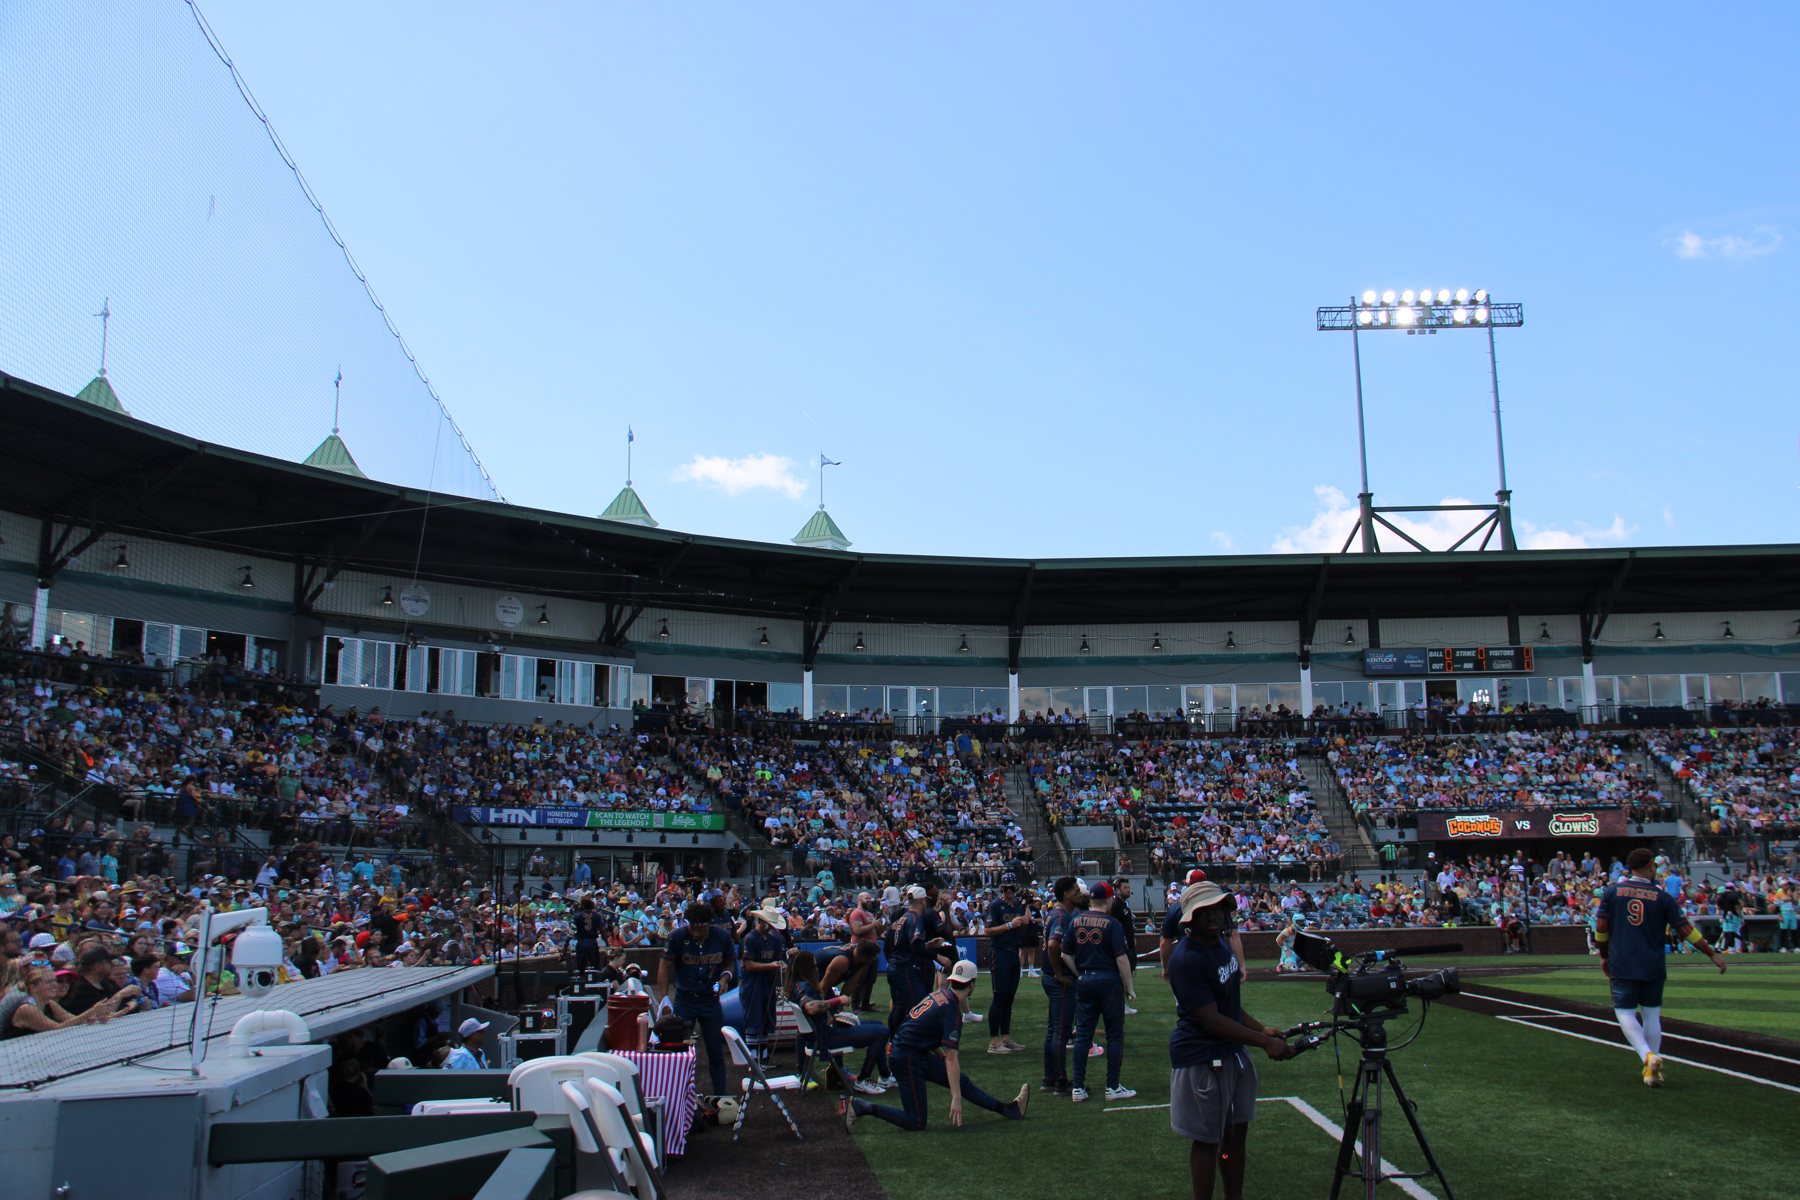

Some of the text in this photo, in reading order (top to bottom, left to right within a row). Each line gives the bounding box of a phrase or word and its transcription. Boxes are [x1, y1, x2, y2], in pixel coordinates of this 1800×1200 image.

[1444, 648, 1452, 660] 0
[1478, 647, 1485, 659] 0
[1524, 646, 1532, 658] 0
[1445, 660, 1453, 672] 0
[488, 808, 537, 824] HTN
[1448, 818, 1596, 835] COCONUTS VS CLOWNS
[1616, 886, 1659, 902] BURGESS
[1626, 898, 1644, 926] 9
[584, 917, 593, 931] 3
